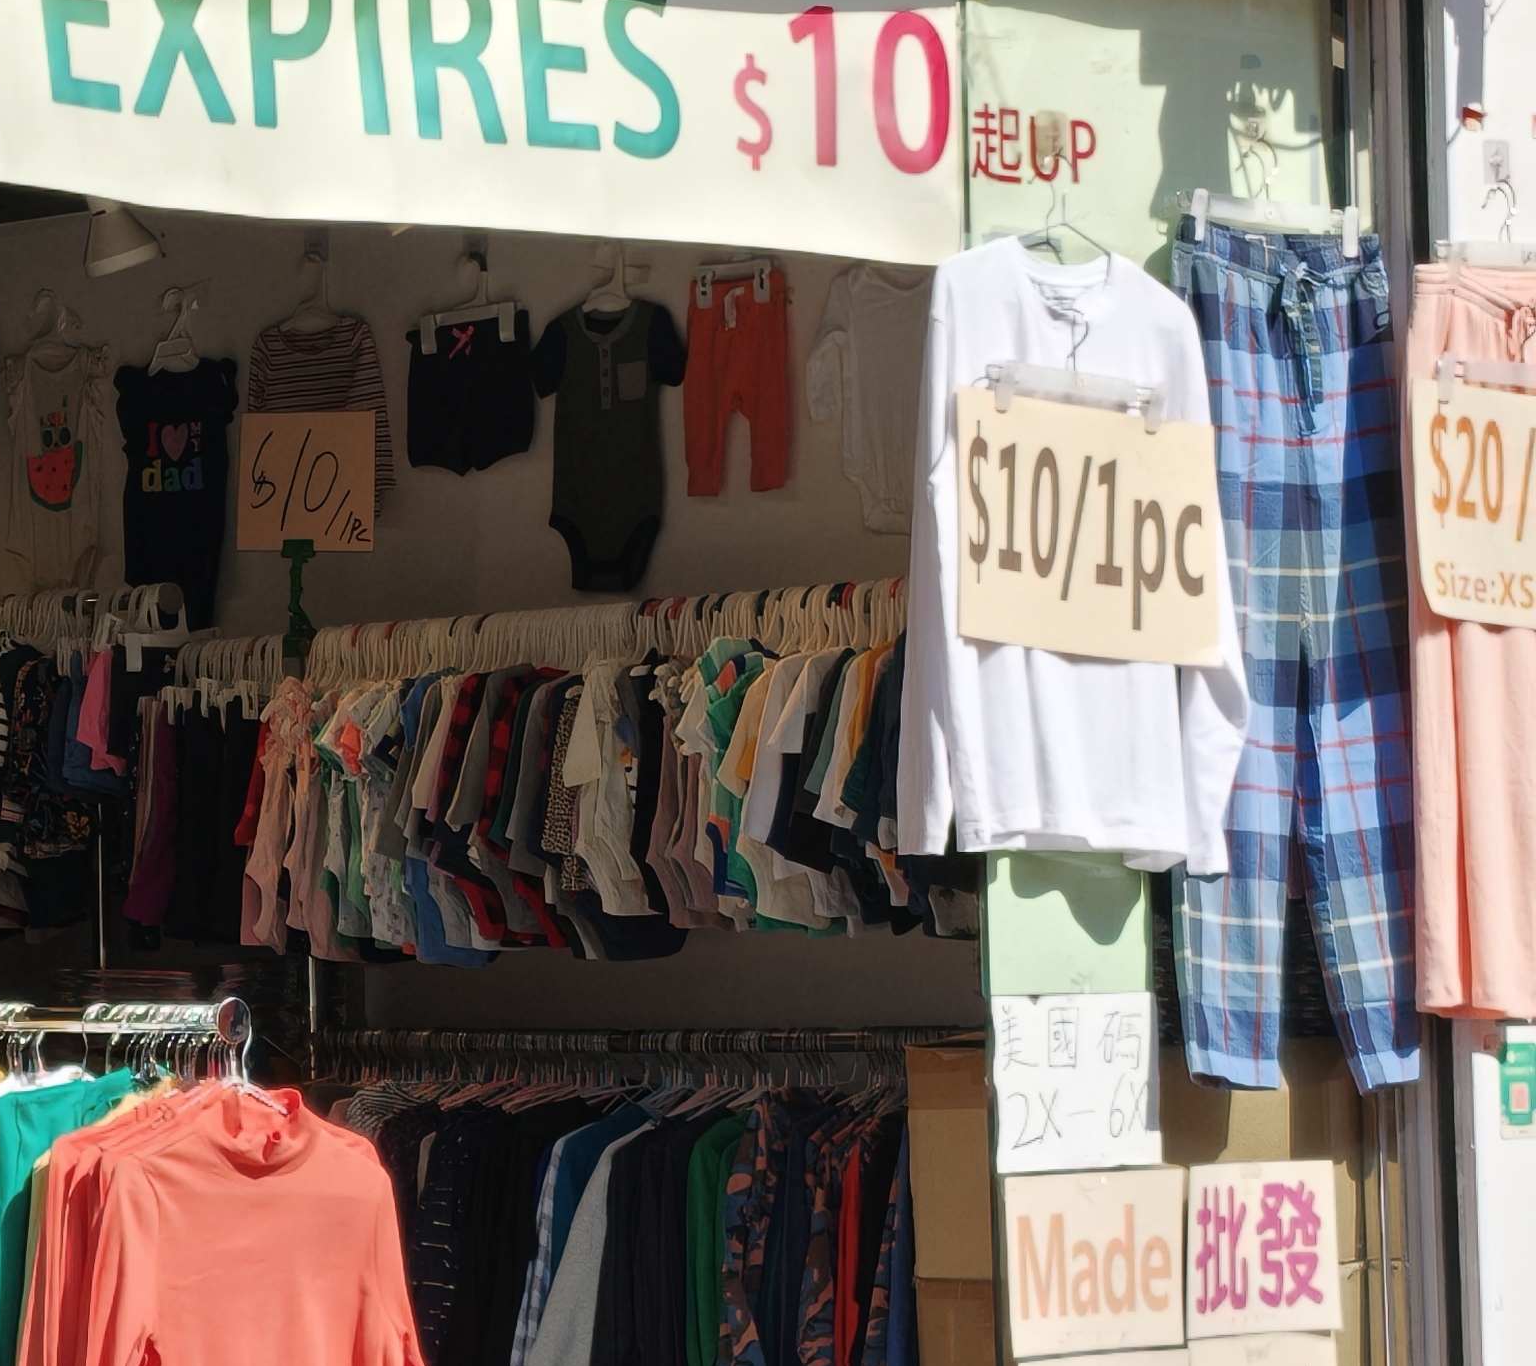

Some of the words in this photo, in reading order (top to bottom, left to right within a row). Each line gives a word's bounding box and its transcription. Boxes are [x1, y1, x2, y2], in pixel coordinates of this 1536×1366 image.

[731, 5, 951, 176] $10
[140, 456, 205, 492] dad
[967, 419, 1205, 632] $10/1pc
[1001, 1004, 1143, 1071] 美國碼
[1016, 1203, 1173, 1320] Made
[1195, 1180, 1323, 1315] 批發
